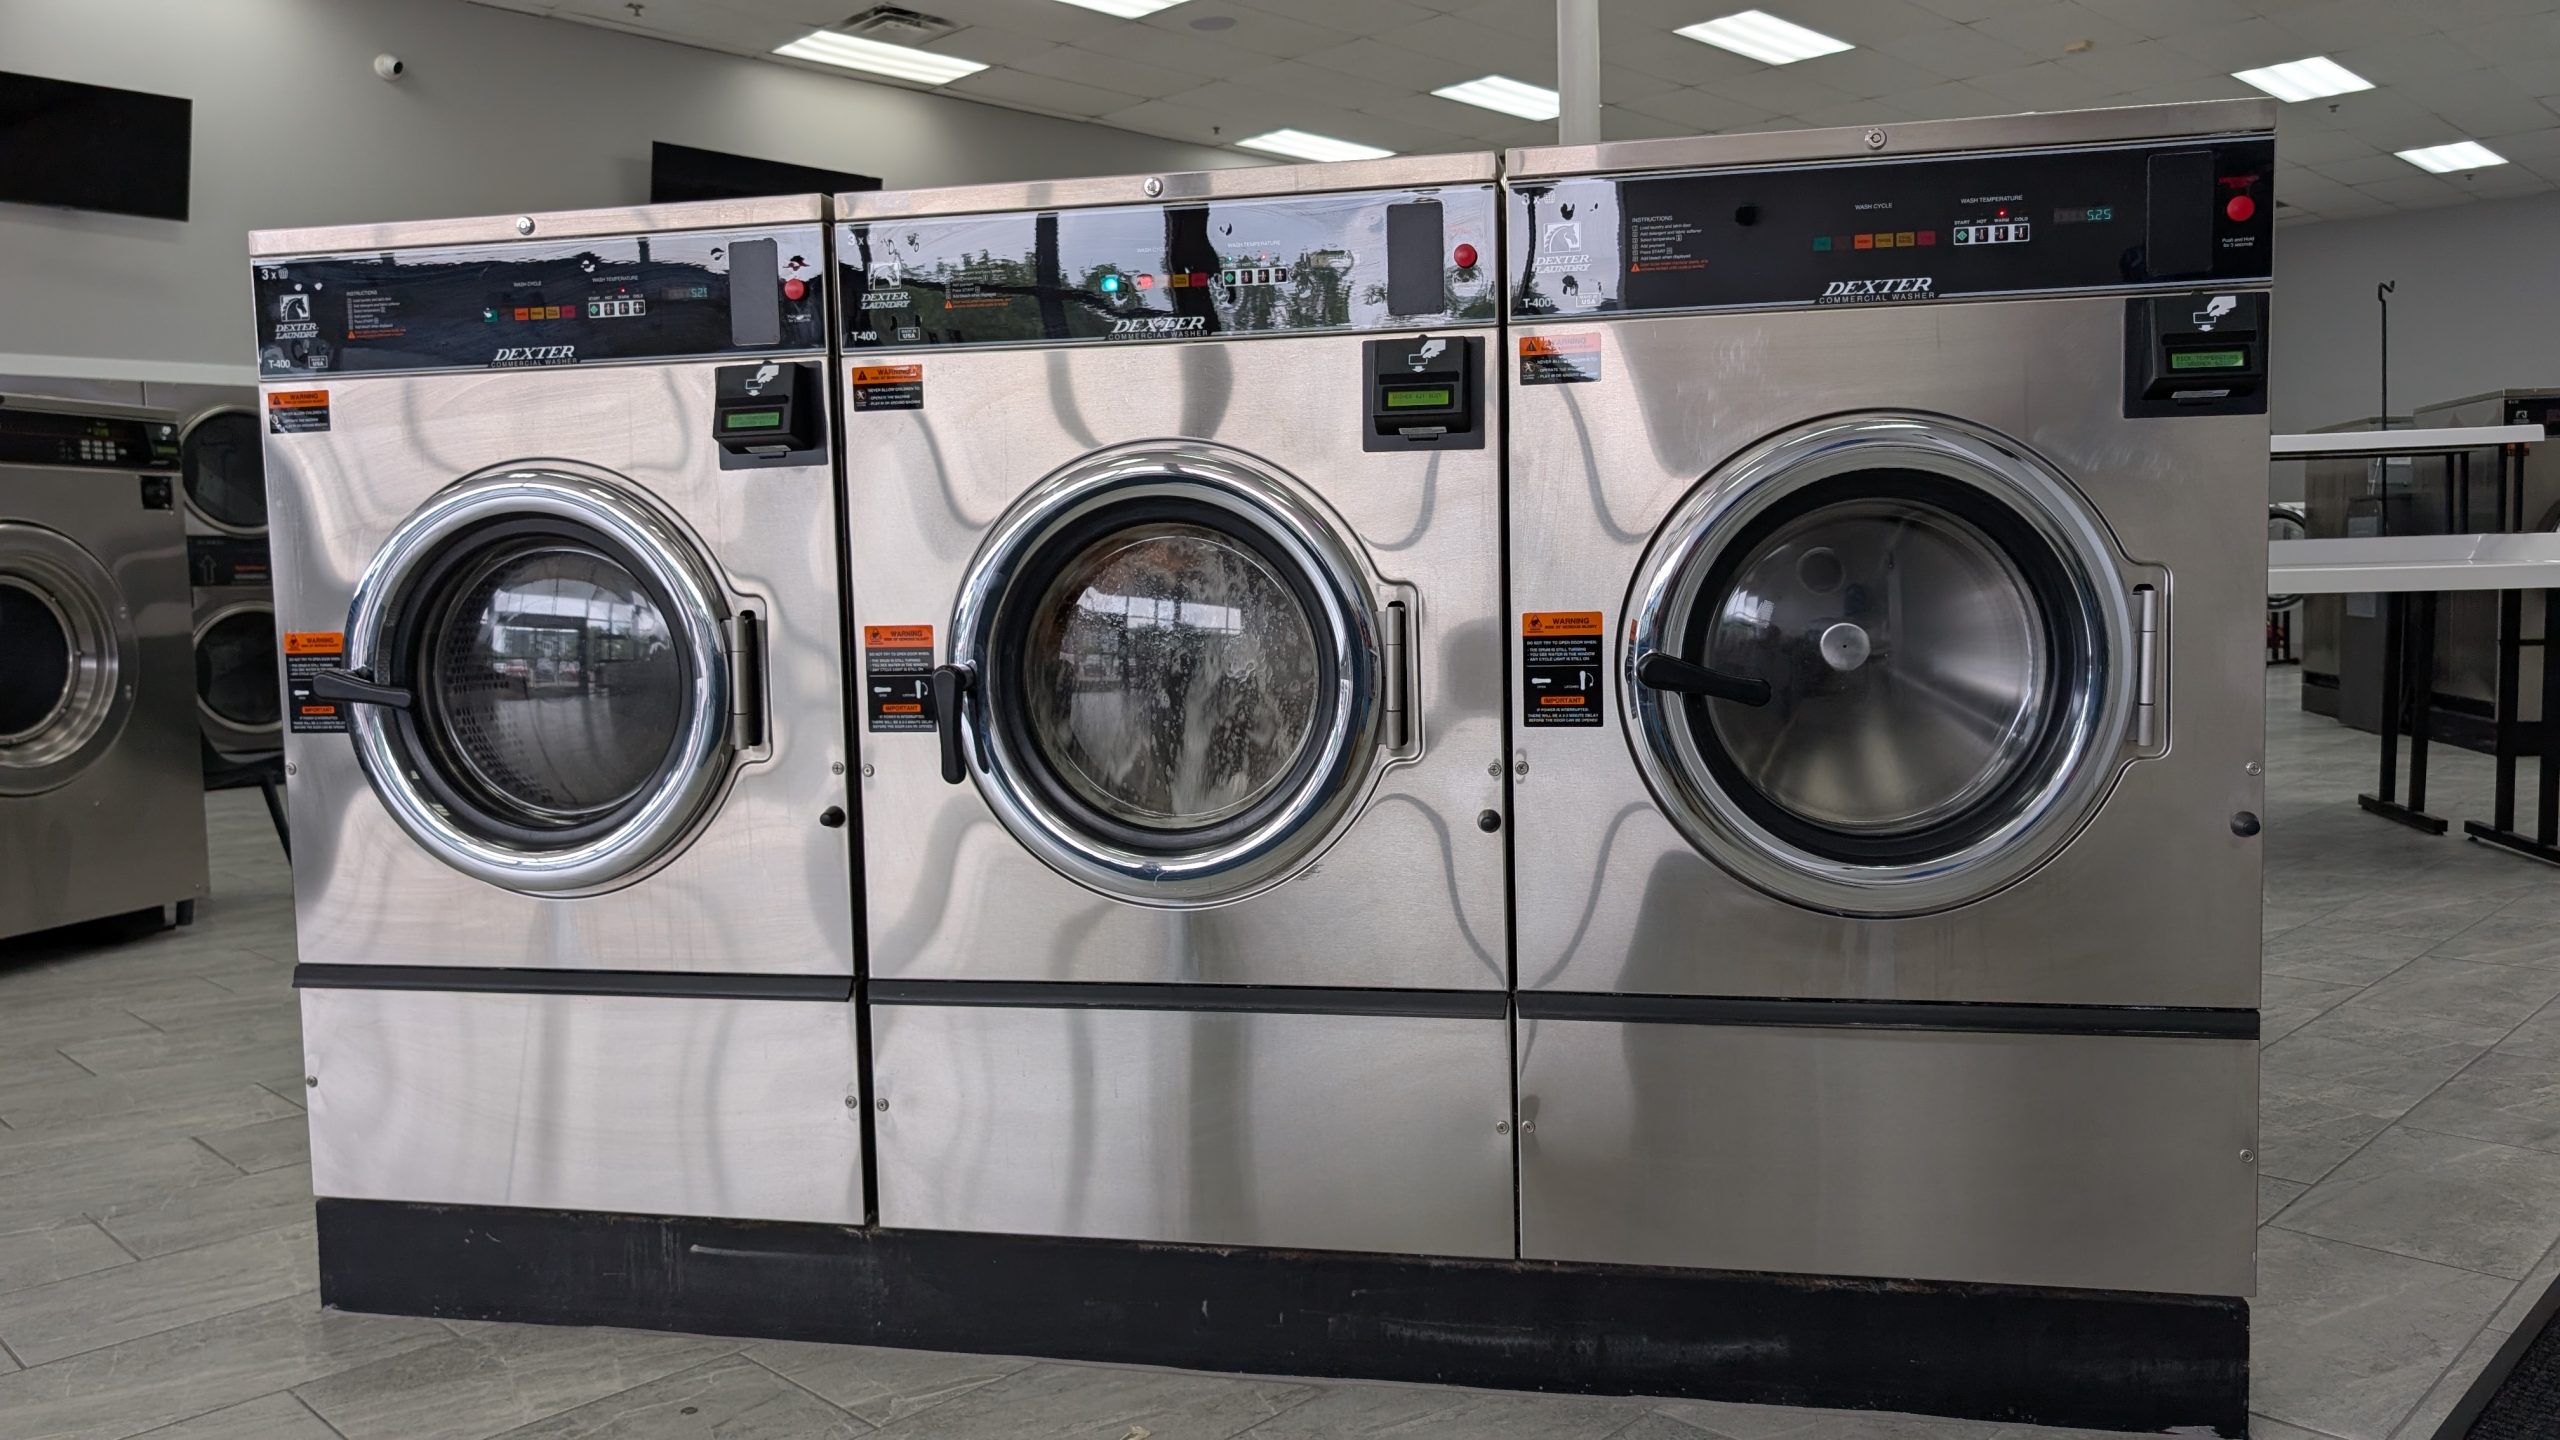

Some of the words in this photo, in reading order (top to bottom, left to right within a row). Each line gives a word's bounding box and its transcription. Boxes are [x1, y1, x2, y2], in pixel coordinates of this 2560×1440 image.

[1535, 255, 1589, 265] DEXTER
[262, 269, 269, 280] 3
[271, 272, 277, 280] x
[1822, 277, 1932, 296] DEXTER
[861, 292, 909, 301] DEXTER
[1819, 294, 1887, 304] COMMERCIAL
[1892, 292, 1935, 301] WASHER
[861, 300, 910, 309] LAUNDRY
[1523, 298, 1550, 308] T-400
[275, 322, 317, 332] DEXTER
[1111, 316, 1205, 333] DEXTER
[852, 332, 877, 341] T-400
[1108, 332, 1167, 340] COMMERCIAL
[1171, 330, 1208, 338] WASHER
[493, 346, 574, 361] DEXTER
[268, 359, 290, 368] T-400
[491, 360, 541, 368] COMMERCIAL
